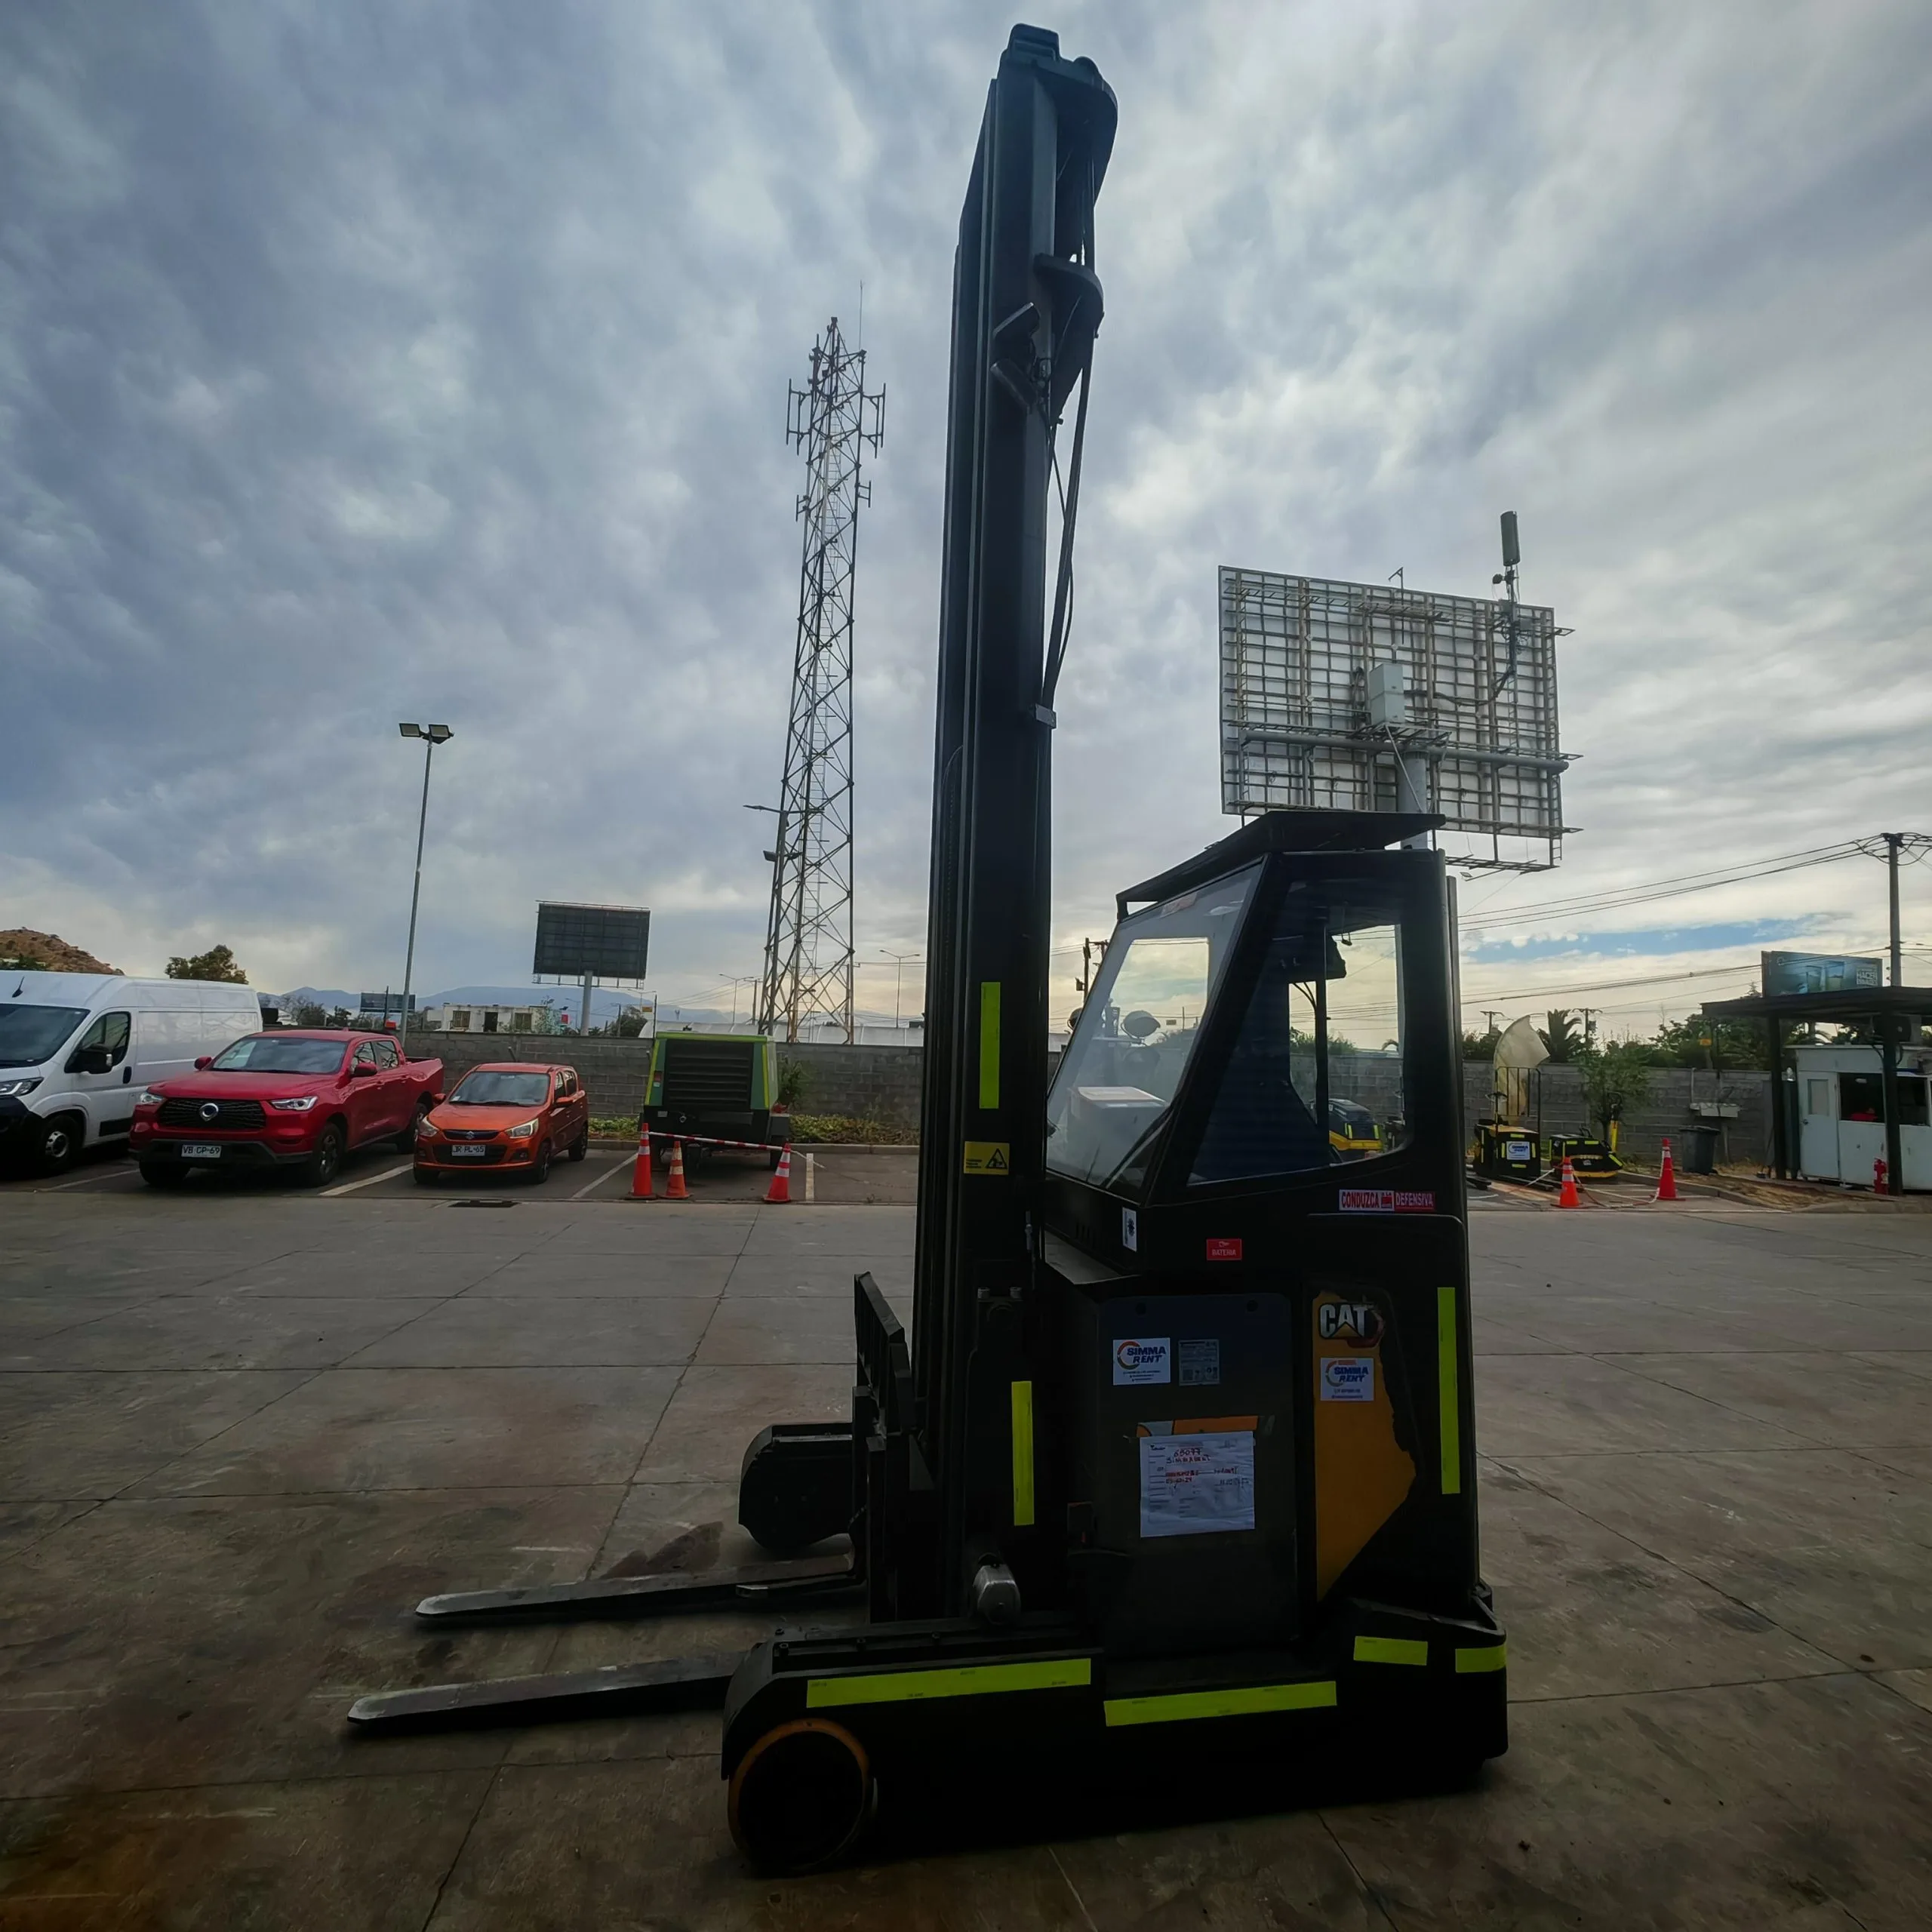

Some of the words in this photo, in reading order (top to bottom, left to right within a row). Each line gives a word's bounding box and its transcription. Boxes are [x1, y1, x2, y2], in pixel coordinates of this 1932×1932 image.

[1342, 1192, 1380, 1208] CONDUZCA
[1395, 1192, 1434, 1207] DEFENSIVA
[1320, 1303, 1368, 1338] CAT
[1127, 1346, 1166, 1356] SIMMA
[1133, 1355, 1162, 1364] RENT
[1334, 1367, 1369, 1375] SIMMA
